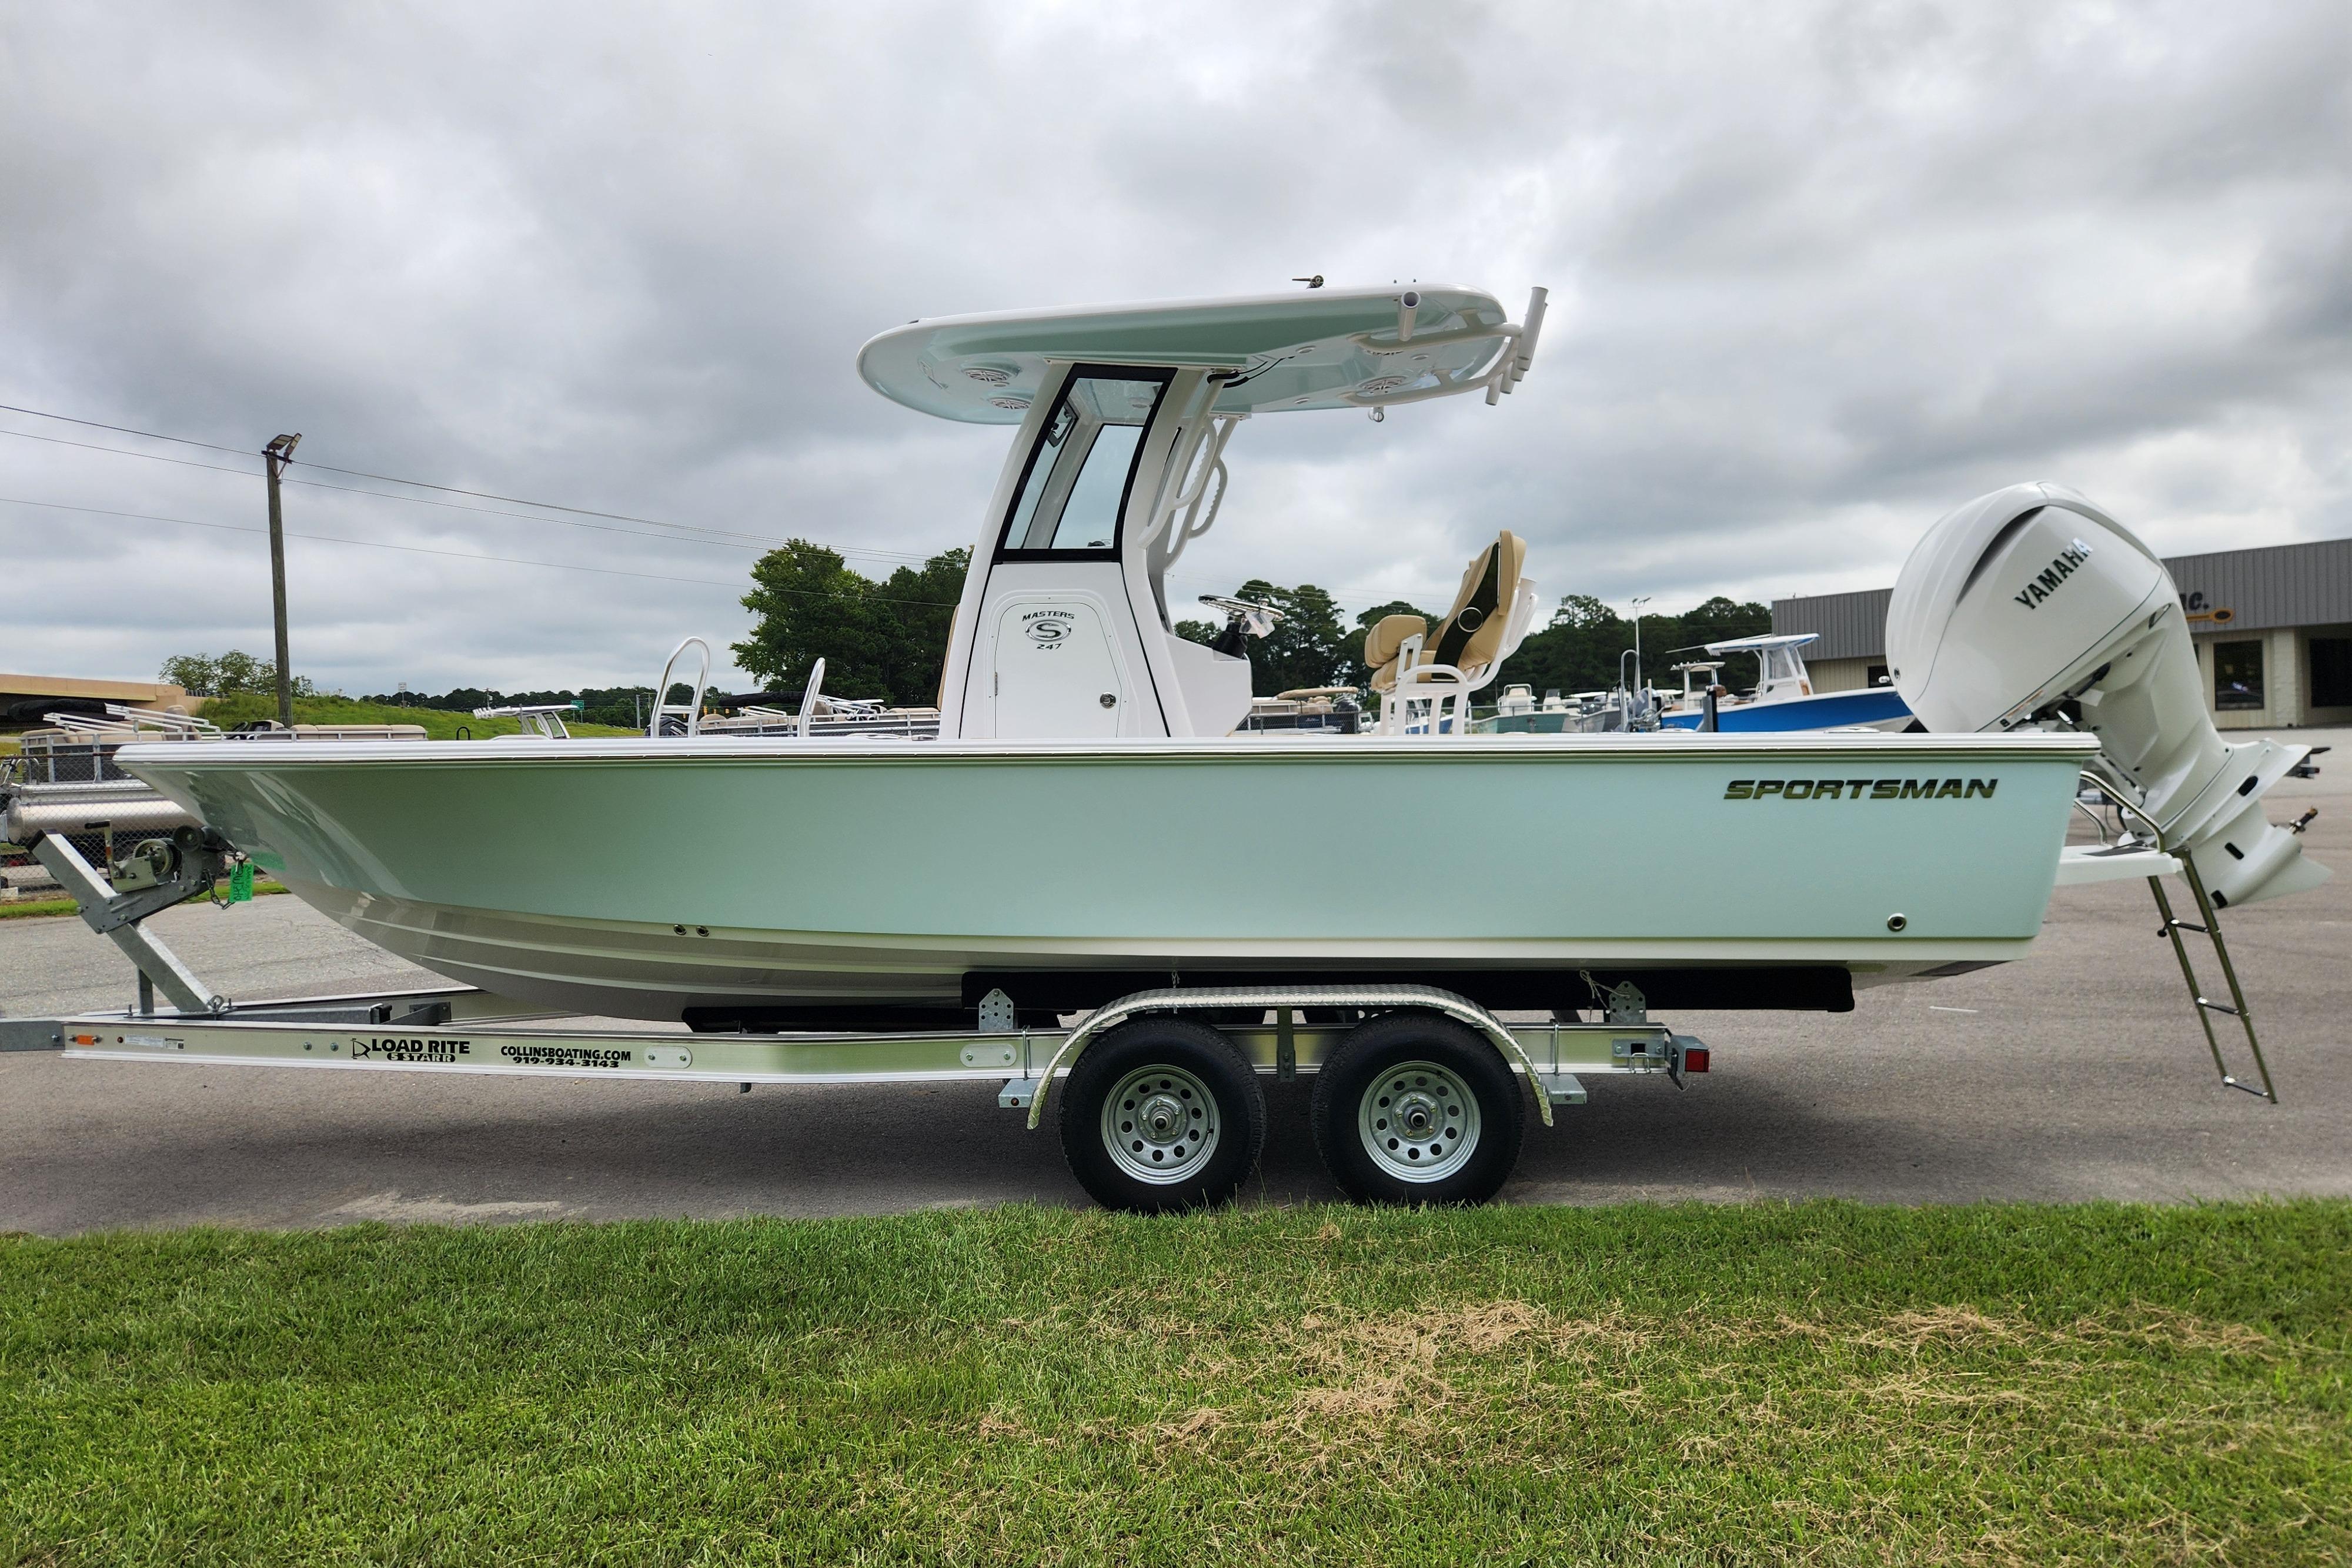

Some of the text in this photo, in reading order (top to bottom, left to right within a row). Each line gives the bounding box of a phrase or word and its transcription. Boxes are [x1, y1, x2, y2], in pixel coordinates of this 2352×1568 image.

[2014, 537, 2093, 610] YAMAHA
[1022, 611, 1075, 621] MASTERS
[1724, 779, 1999, 800] SPORTSMAN
[372, 1038, 470, 1054] LOAD RITE
[500, 1046, 632, 1061] COLLINSBOATING.COM
[390, 1053, 452, 1062] 5 STARR
[512, 1057, 620, 1068] 919-934-3143
